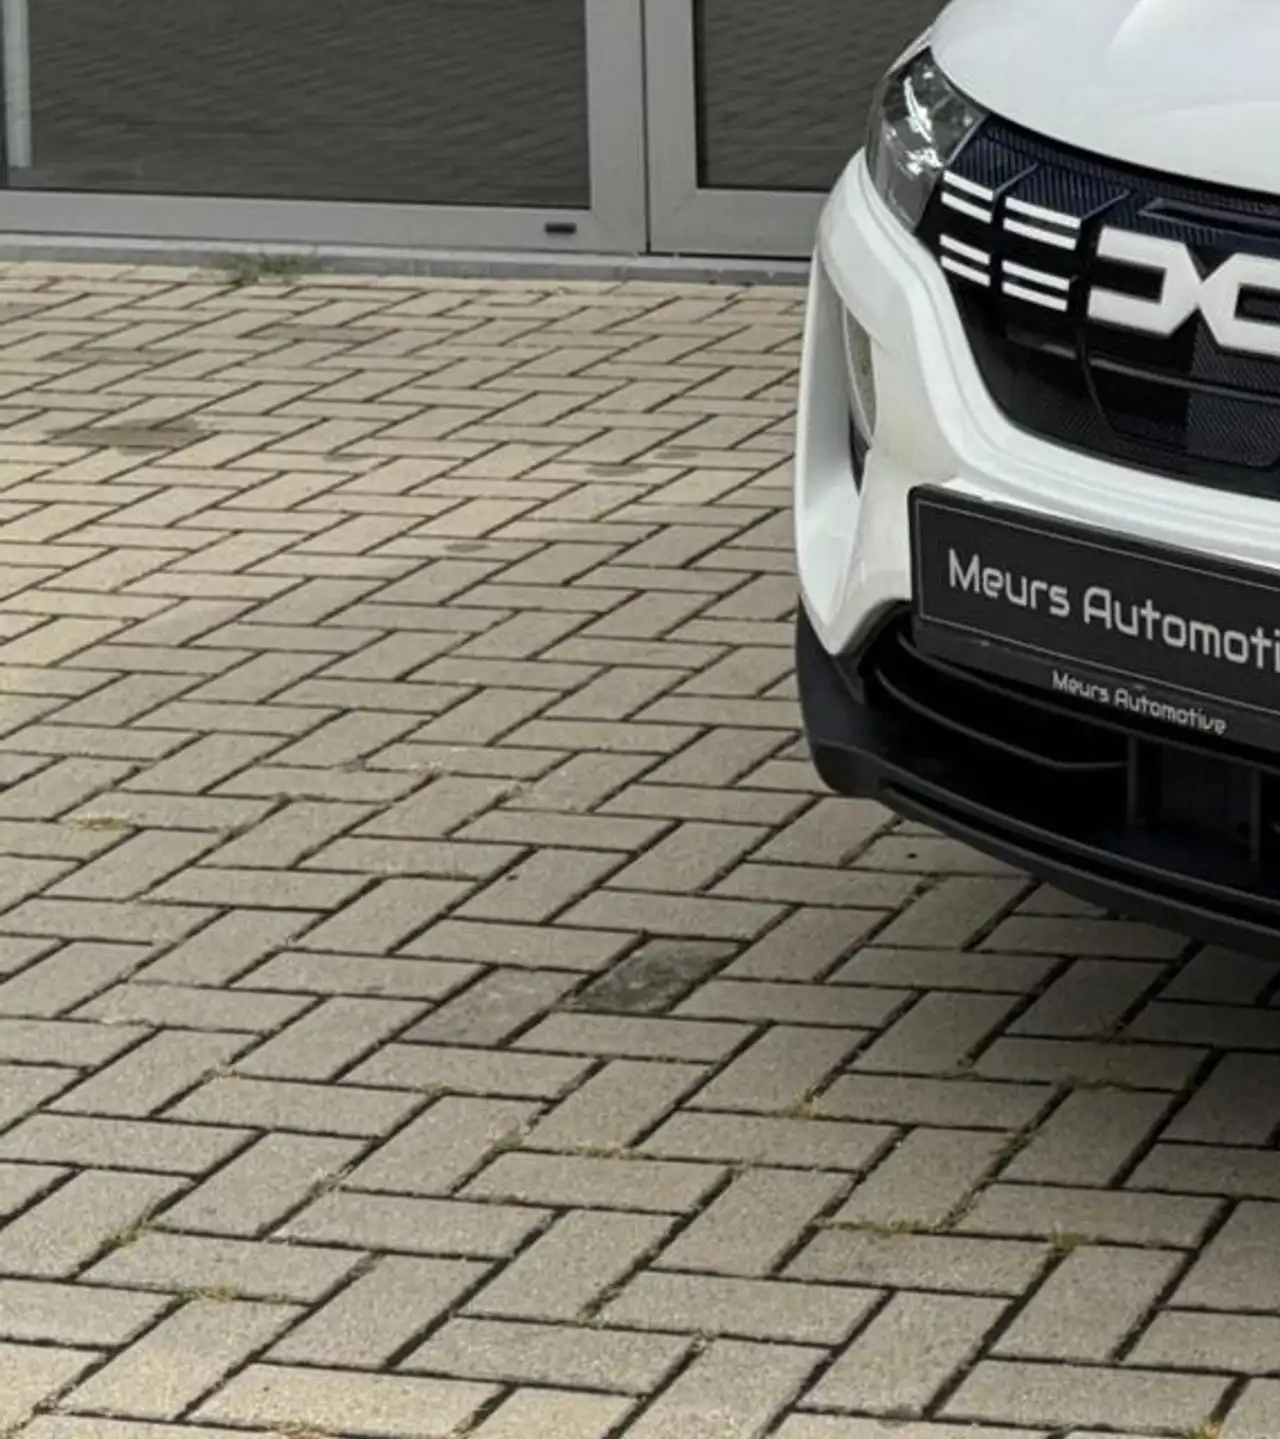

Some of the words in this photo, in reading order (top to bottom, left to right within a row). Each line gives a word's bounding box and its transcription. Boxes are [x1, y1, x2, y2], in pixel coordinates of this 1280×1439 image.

[948, 548, 1070, 618] Meurs
[1051, 670, 1110, 703] Meurs
[1114, 687, 1228, 736] Automotive
